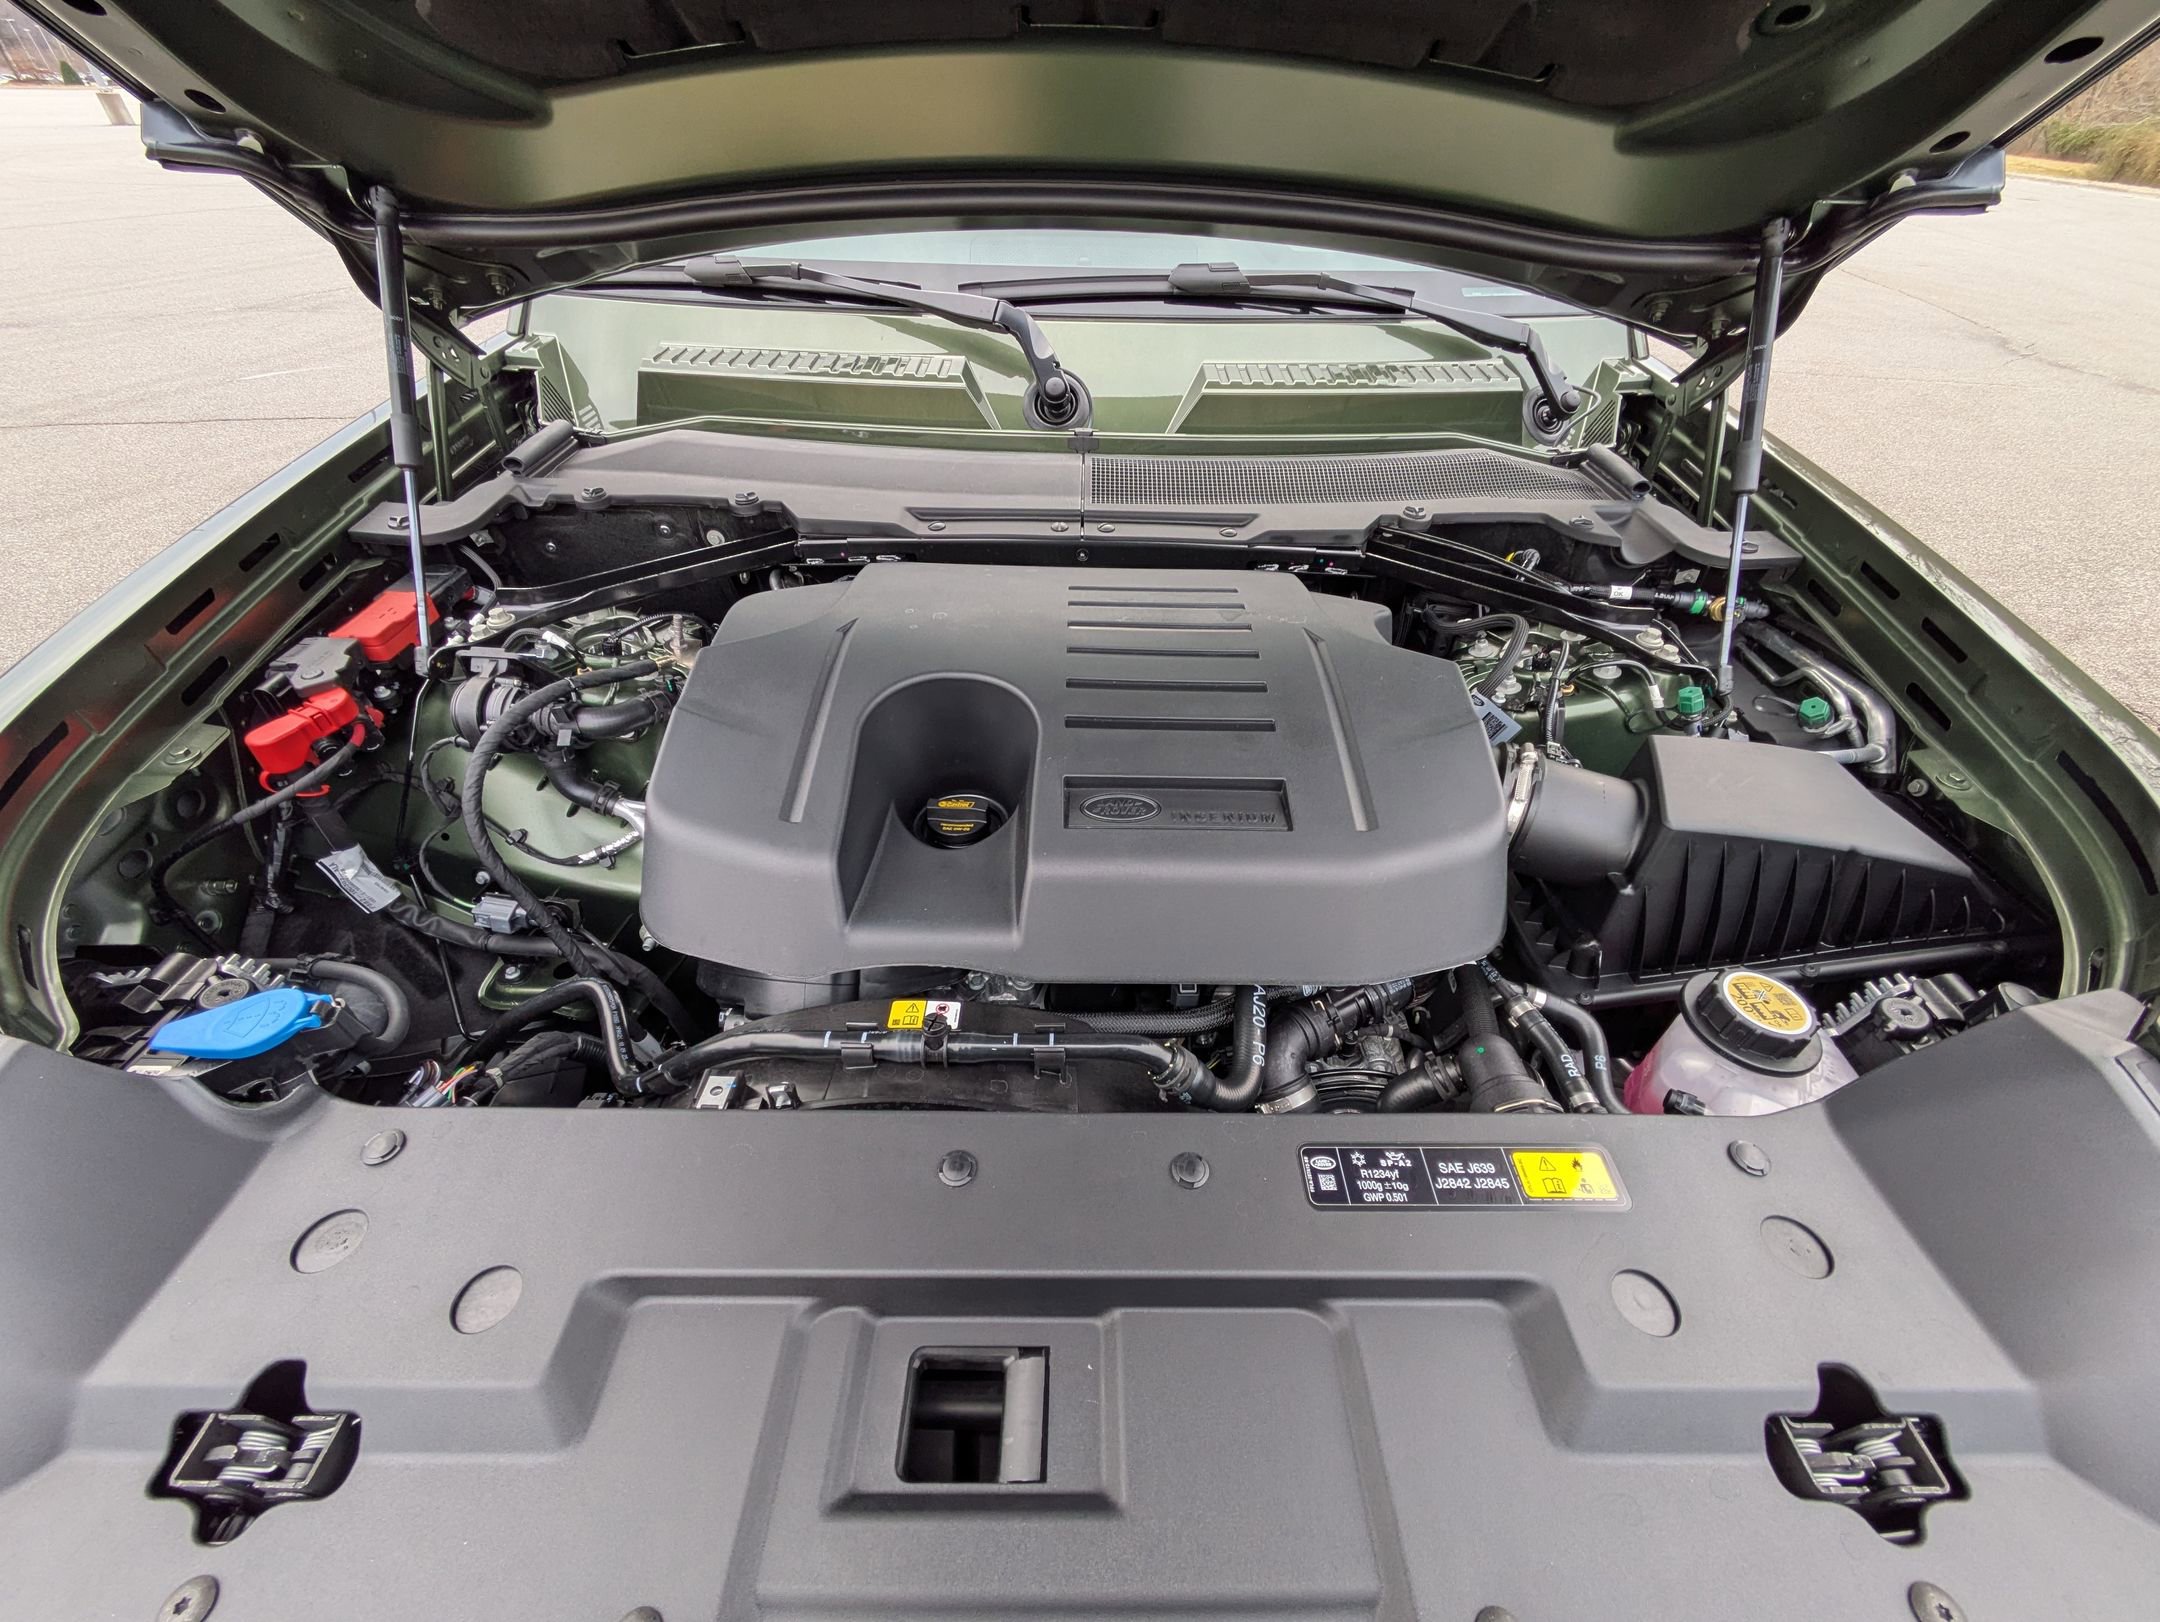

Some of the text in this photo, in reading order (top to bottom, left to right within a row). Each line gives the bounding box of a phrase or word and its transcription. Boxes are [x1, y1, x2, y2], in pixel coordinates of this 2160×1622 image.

[1730, 993, 1754, 1013] 200
[1561, 1054, 1581, 1077] RAD
[1380, 1159, 1412, 1167] SP-A2
[1438, 1162, 1496, 1174] SAE J639
[1360, 1169, 1400, 1180] R1234yf
[1357, 1181, 1409, 1191] 1000g ±10g
[1435, 1178, 1510, 1189] J2842 J2845
[1363, 1193, 1408, 1202] GWP 0.501
